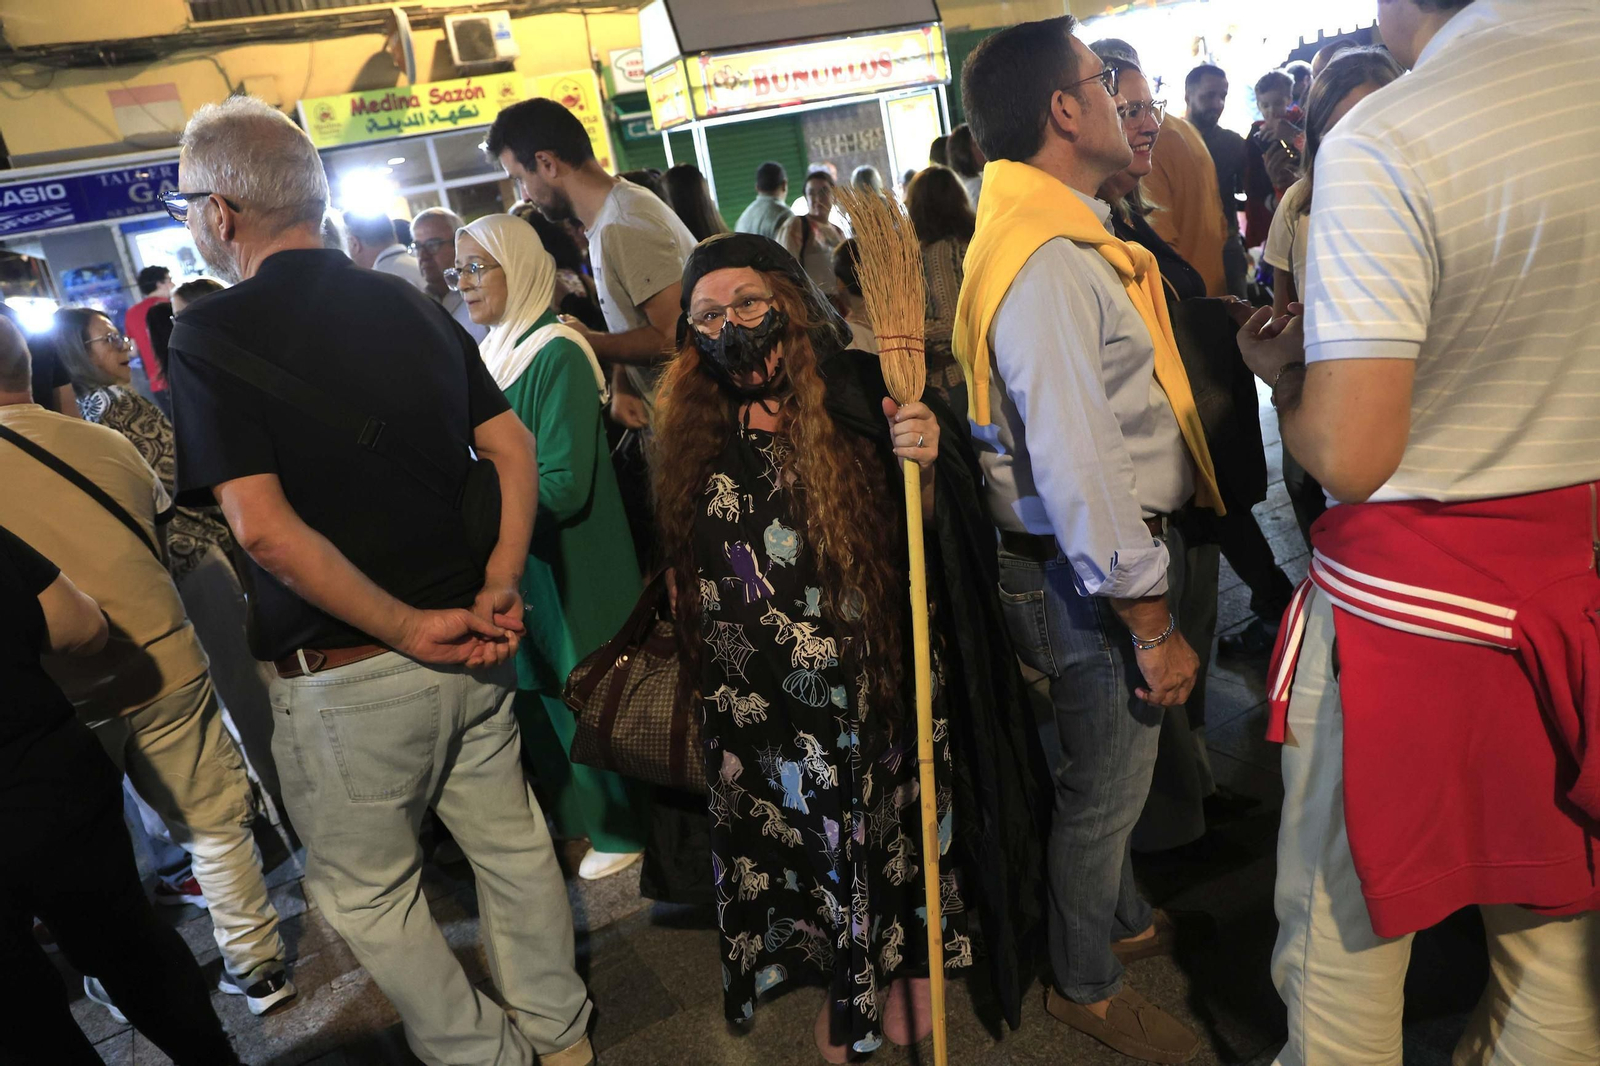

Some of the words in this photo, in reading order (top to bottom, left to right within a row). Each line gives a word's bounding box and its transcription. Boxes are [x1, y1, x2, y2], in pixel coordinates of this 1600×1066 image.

[350, 93, 420, 117] Medina
[429, 80, 486, 105] Sazón
[0, 183, 68, 208] ASIO
[127, 179, 178, 204] GA
